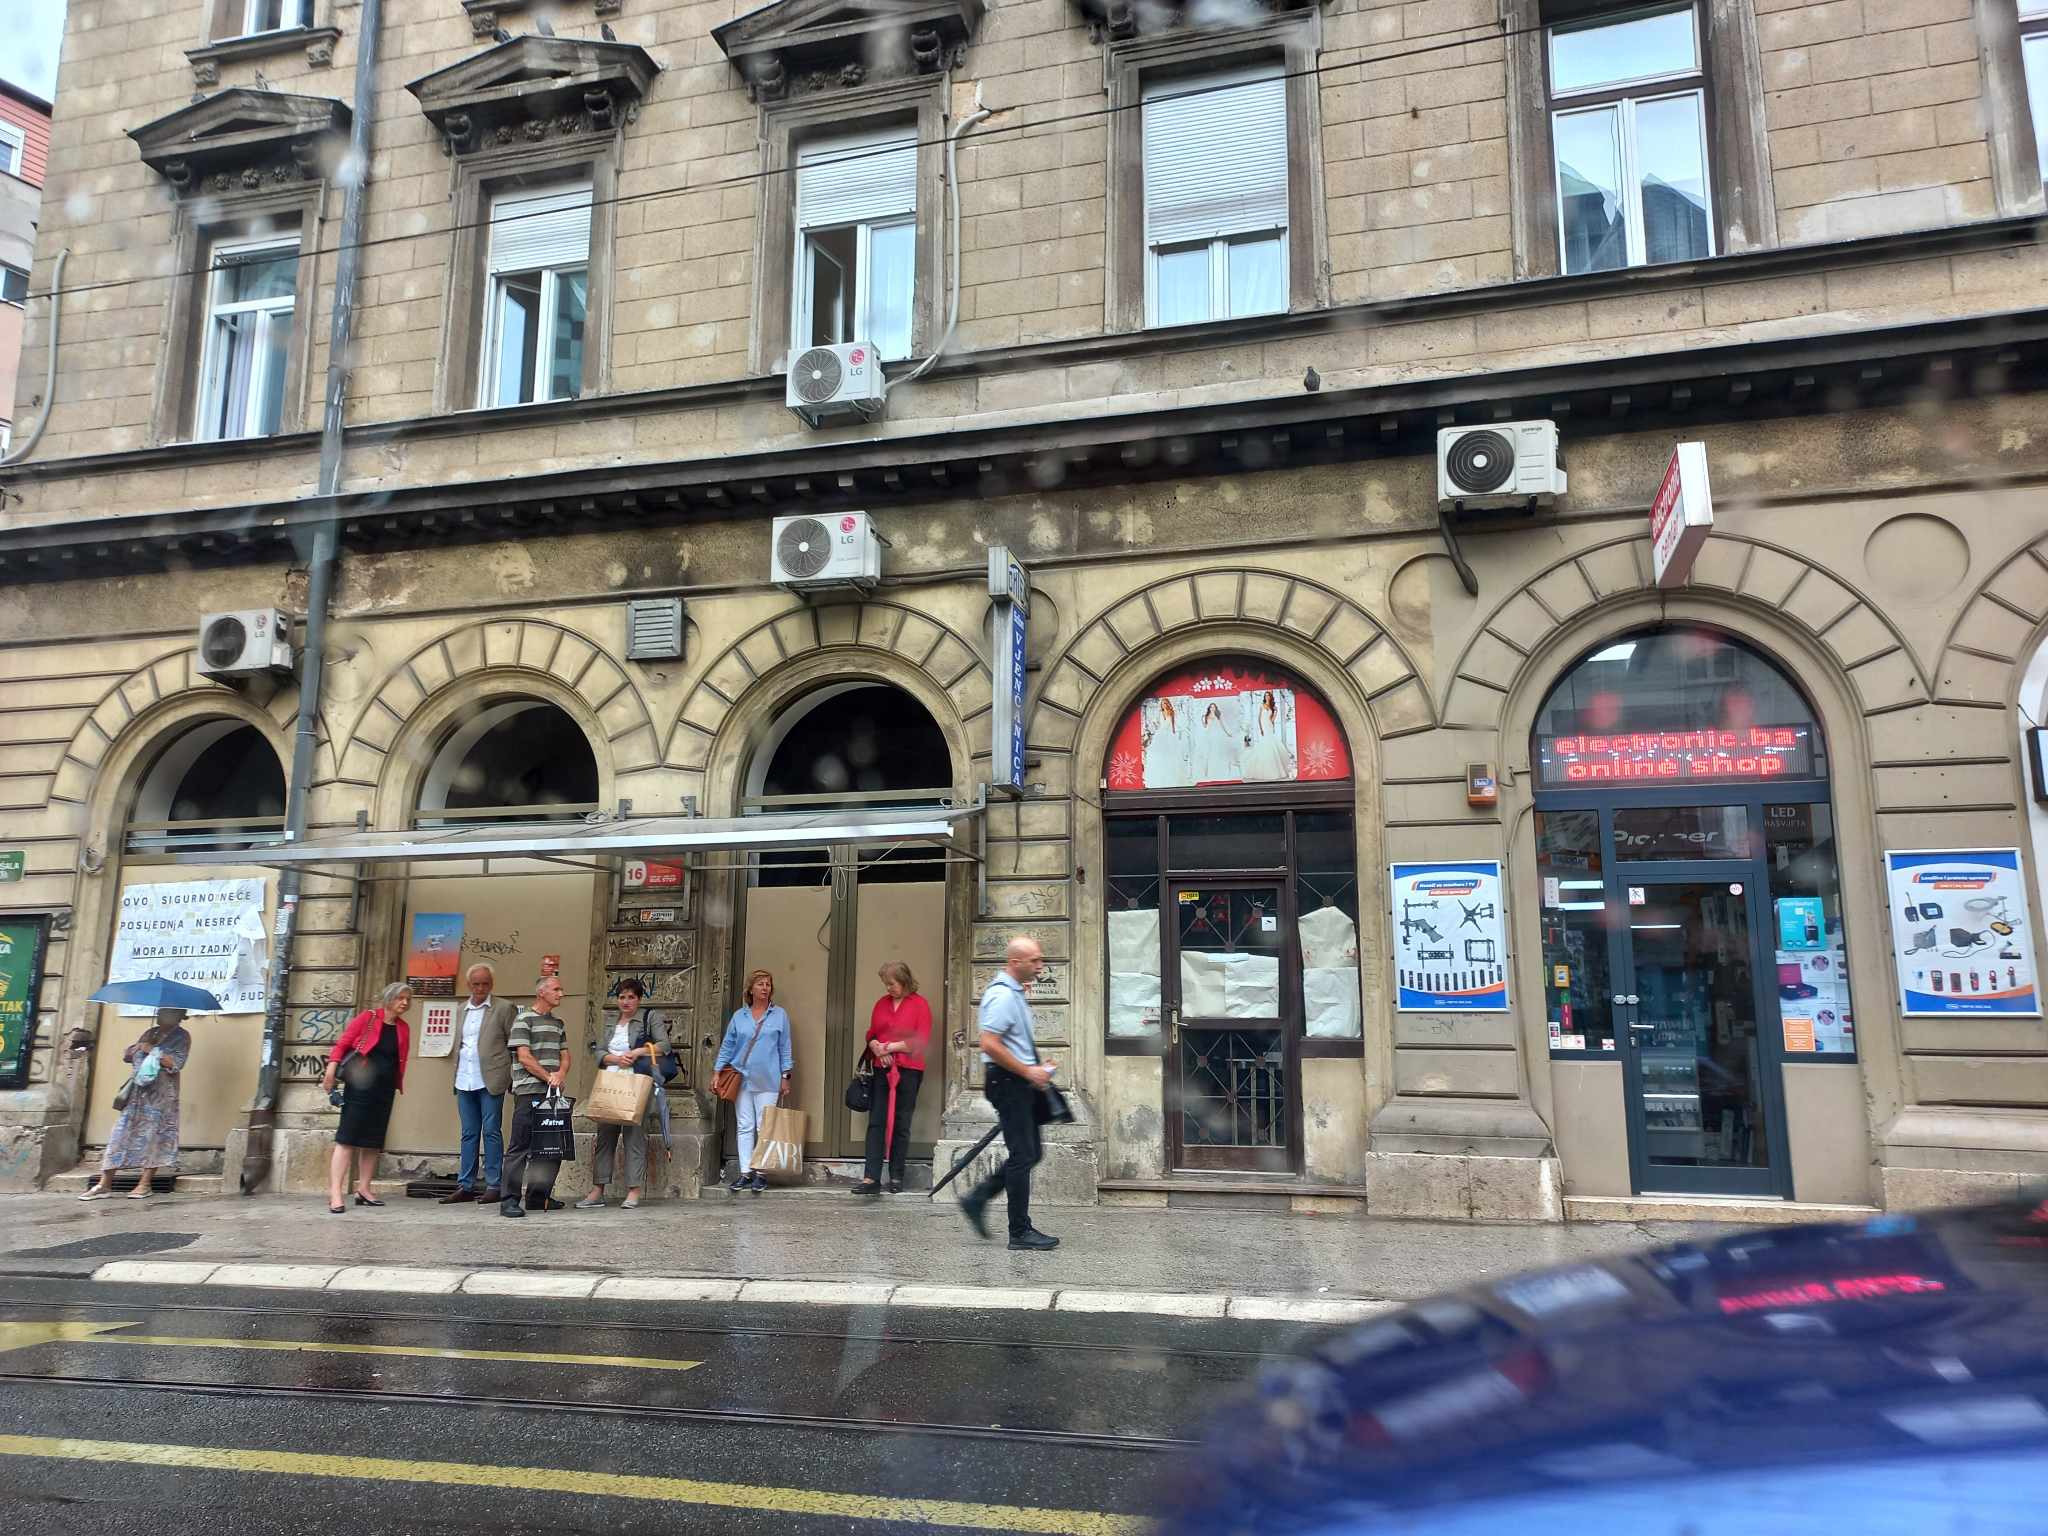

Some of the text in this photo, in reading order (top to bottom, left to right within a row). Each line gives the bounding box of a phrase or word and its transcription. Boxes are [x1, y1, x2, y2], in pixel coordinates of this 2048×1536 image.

[850, 367, 863, 376] LG
[840, 535, 855, 545] LG
[1556, 728, 1794, 754] electronic.ba
[1567, 754, 1783, 781] online shop
[1771, 807, 1796, 818] LED
[627, 868, 642, 880] 16
[123, 897, 148, 907] OVO
[161, 893, 214, 905] SIGURNO
[132, 946, 165, 956] MORA
[171, 945, 194, 955] BITI
[174, 971, 205, 980] KOJU
